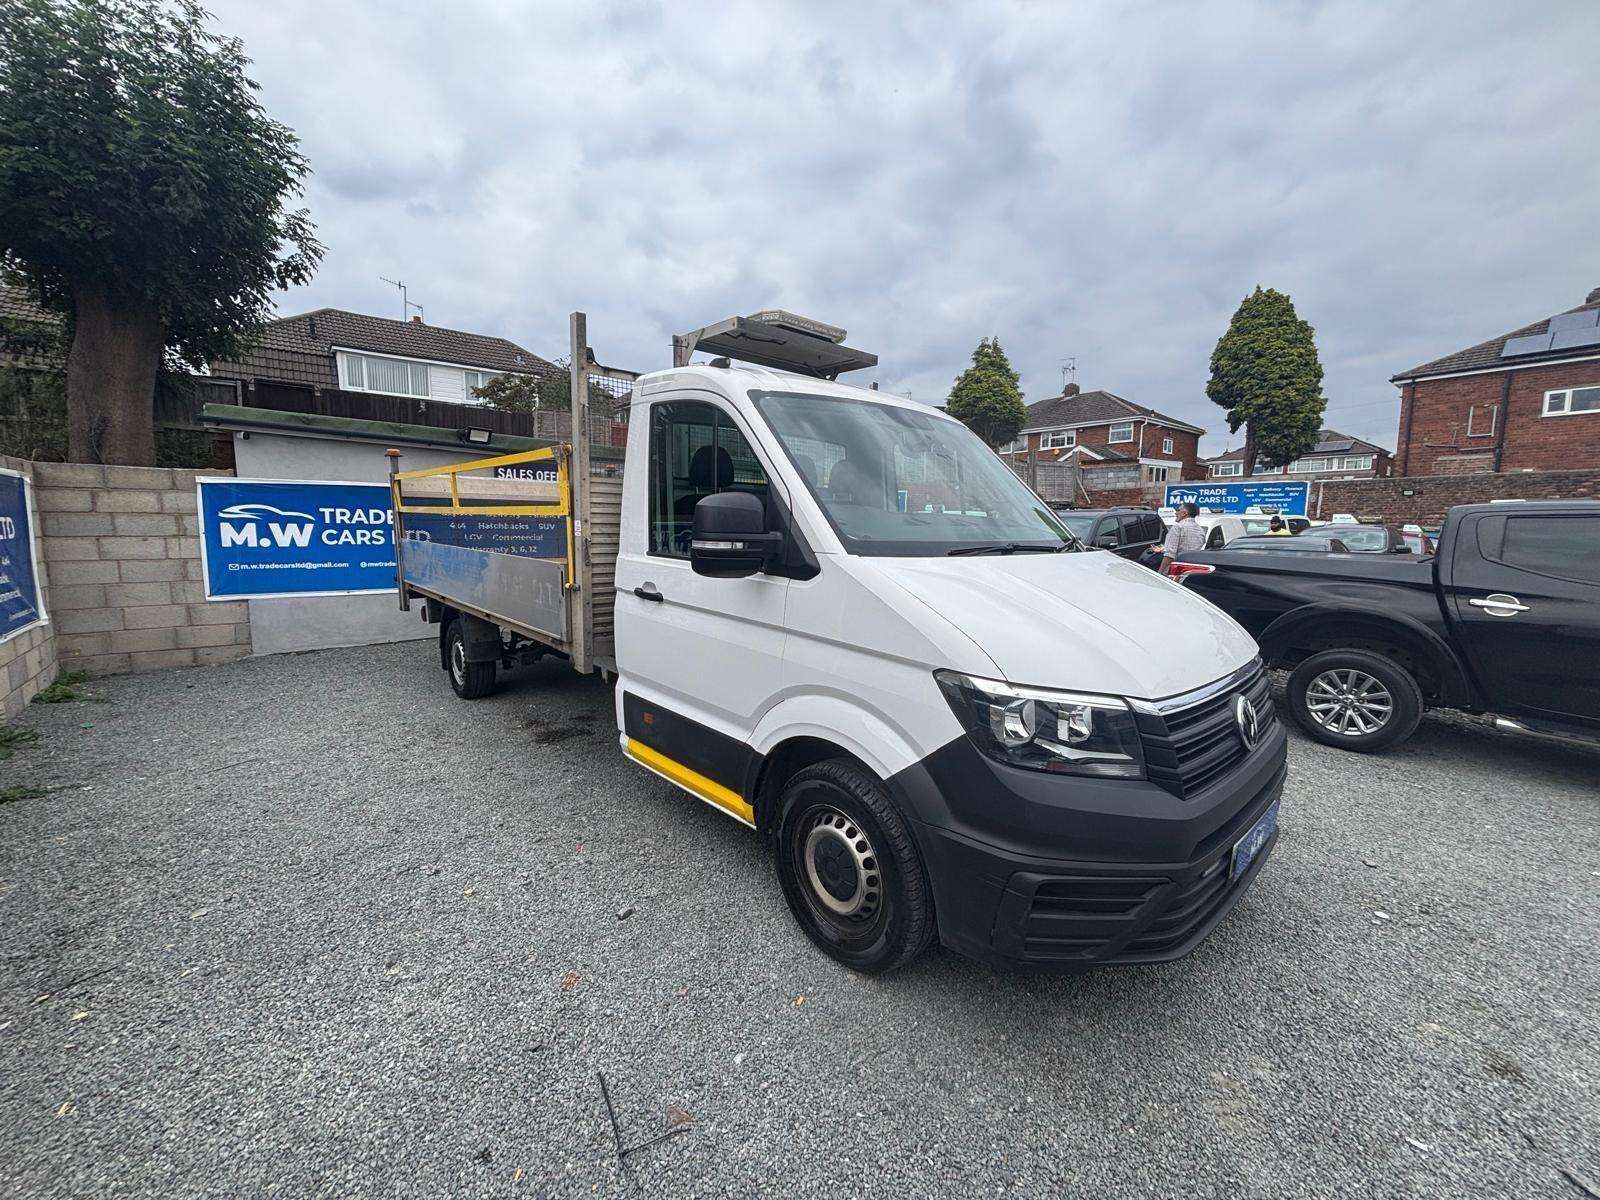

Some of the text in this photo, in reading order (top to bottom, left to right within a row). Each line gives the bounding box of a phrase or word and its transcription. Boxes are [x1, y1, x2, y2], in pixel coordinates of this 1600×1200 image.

[497, 467, 534, 481] SALES
[1199, 488, 1227, 496] TRADE
[1169, 495, 1197, 505] M.W
[1199, 496, 1220, 504] CARS
[319, 508, 393, 525] TRADE
[478, 521, 529, 530] Hatchbacks
[538, 522, 555, 531] SUV
[221, 522, 314, 548] M.W
[321, 528, 385, 546] CARS
[493, 533, 544, 541] Commercial
